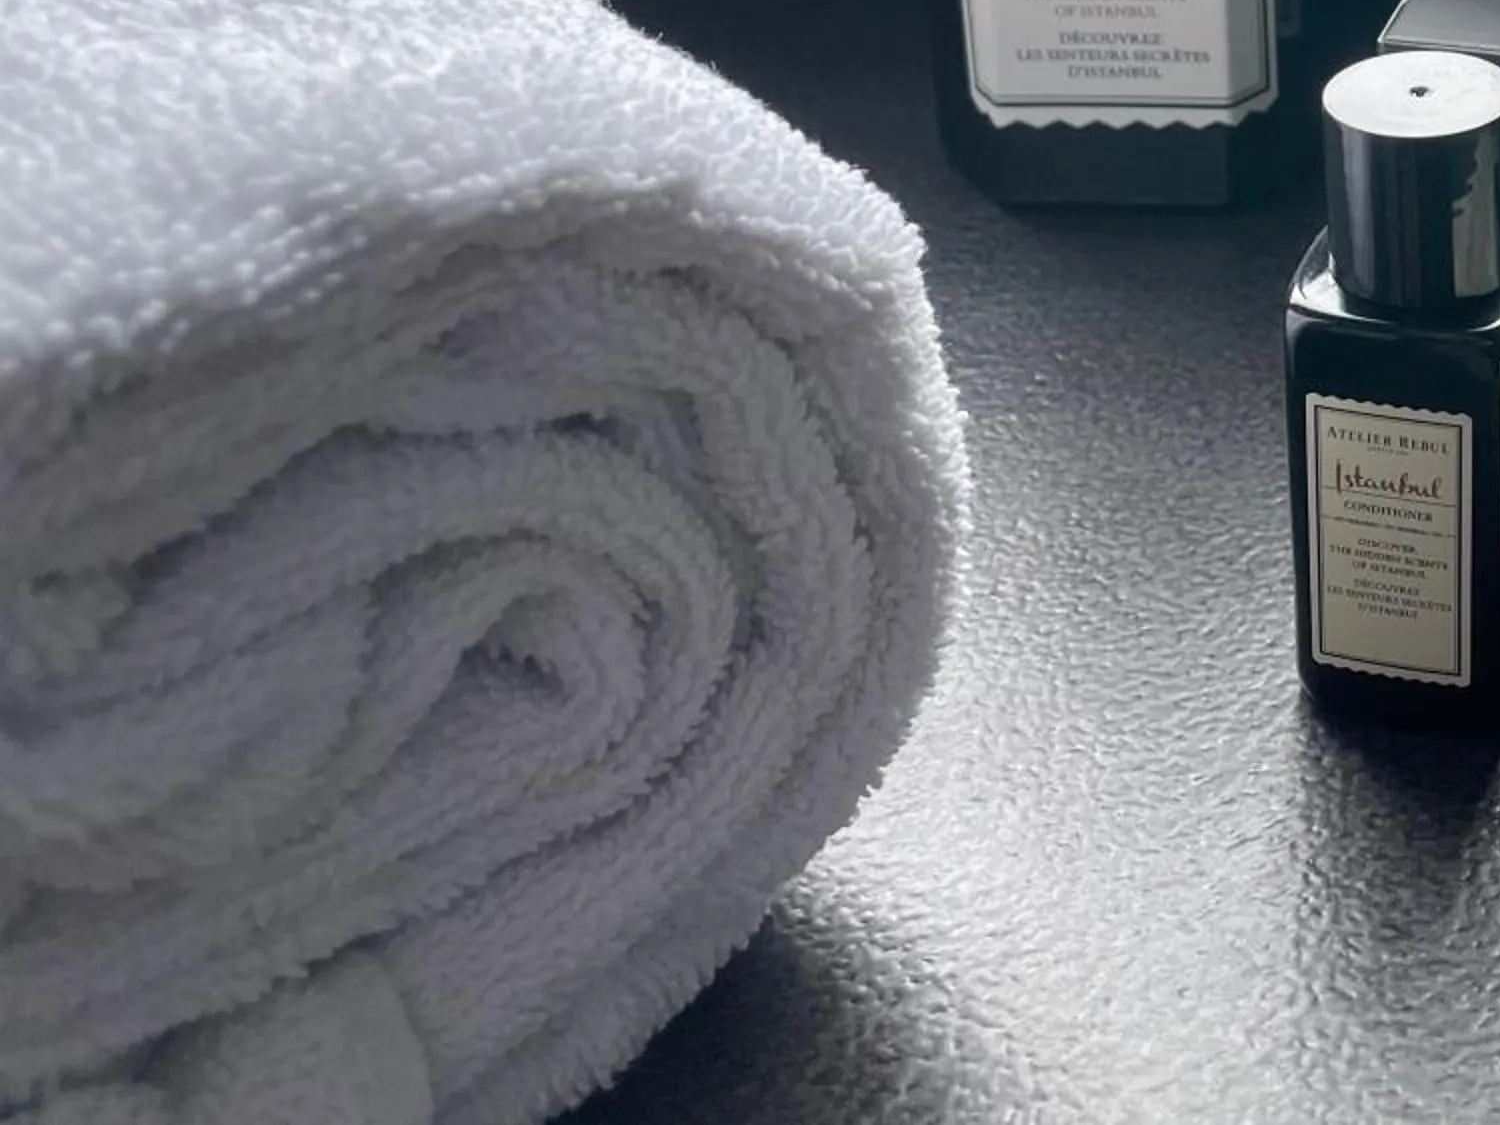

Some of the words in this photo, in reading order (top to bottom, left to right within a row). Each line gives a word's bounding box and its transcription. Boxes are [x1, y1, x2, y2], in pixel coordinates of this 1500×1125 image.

[1054, 5, 1077, 18] OF
[1081, 5, 1157, 18] ISTANBUL
[1016, 48, 1042, 62] LES
[1046, 48, 1129, 62] SENTEURS
[1327, 425, 1391, 448] ATELIER
[1400, 435, 1450, 455] REBUL
[1343, 500, 1433, 523] CONDITIONER
